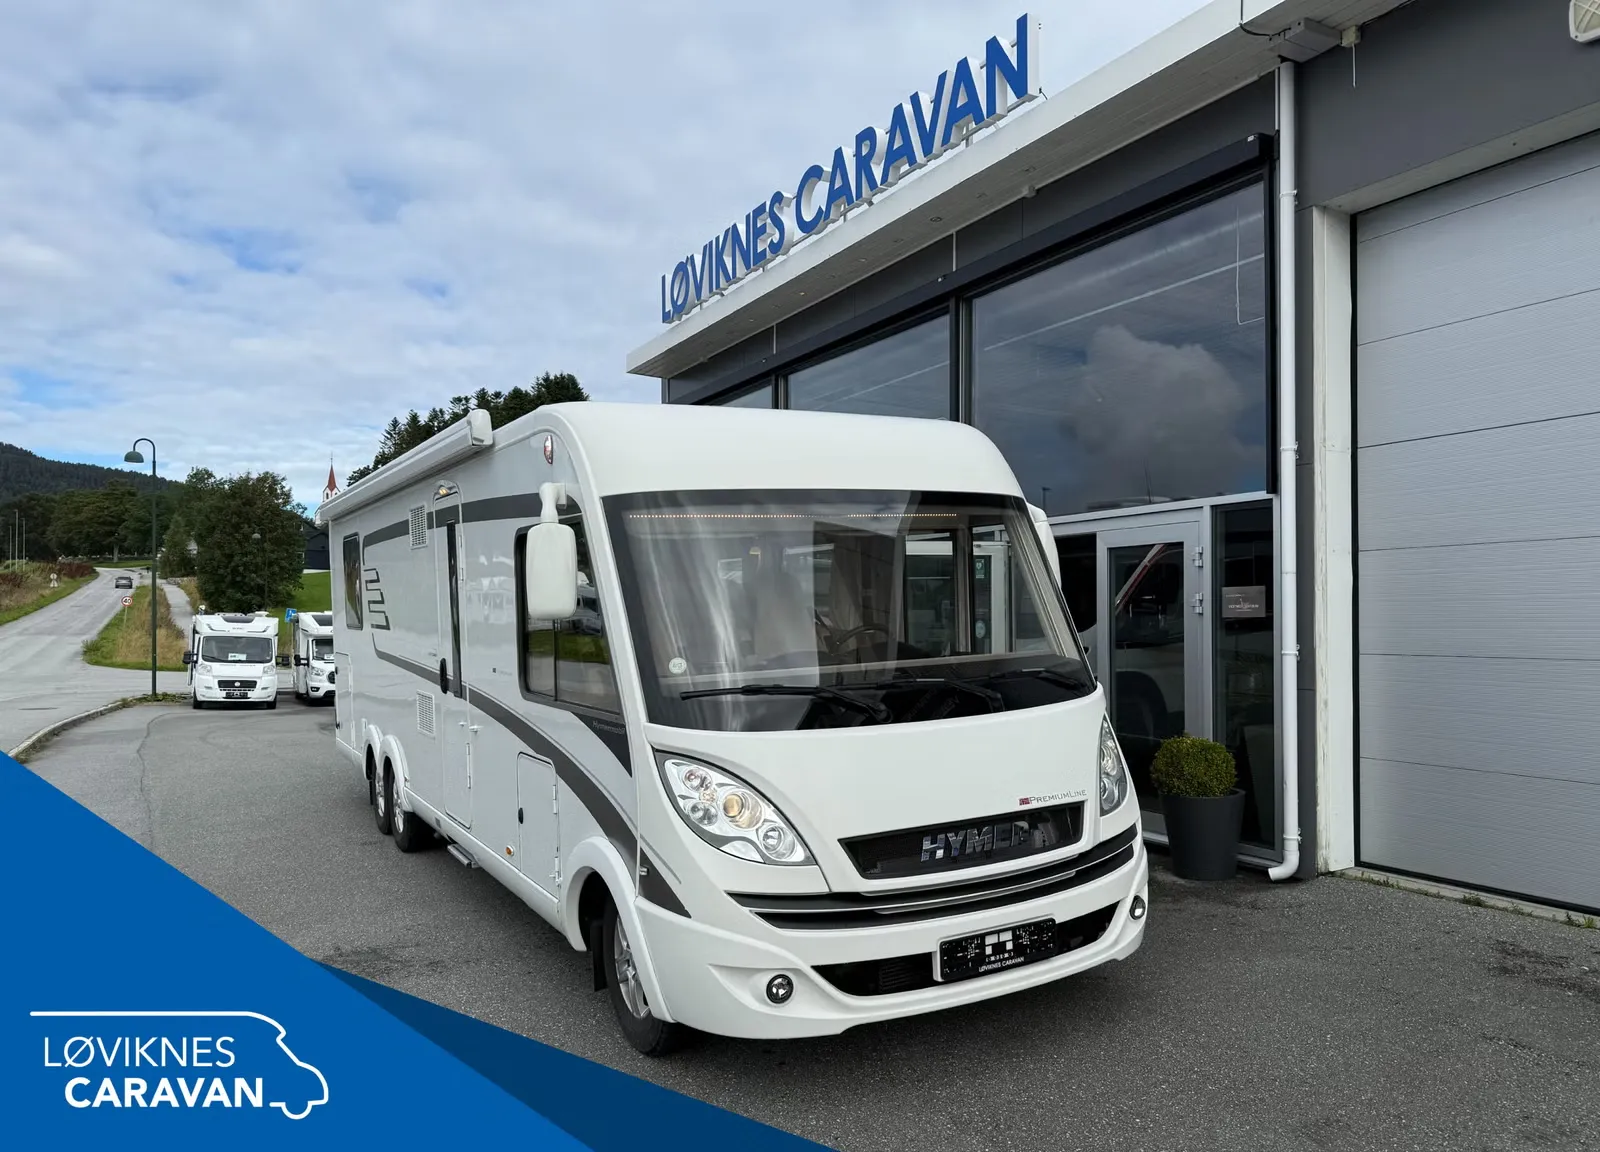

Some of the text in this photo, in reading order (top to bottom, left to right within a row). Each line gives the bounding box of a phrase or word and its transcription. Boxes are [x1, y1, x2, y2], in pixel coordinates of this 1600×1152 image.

[661, 12, 1035, 324] LØVIKNES CARAVAN
[1001, 956, 1025, 967] CARAVAN
